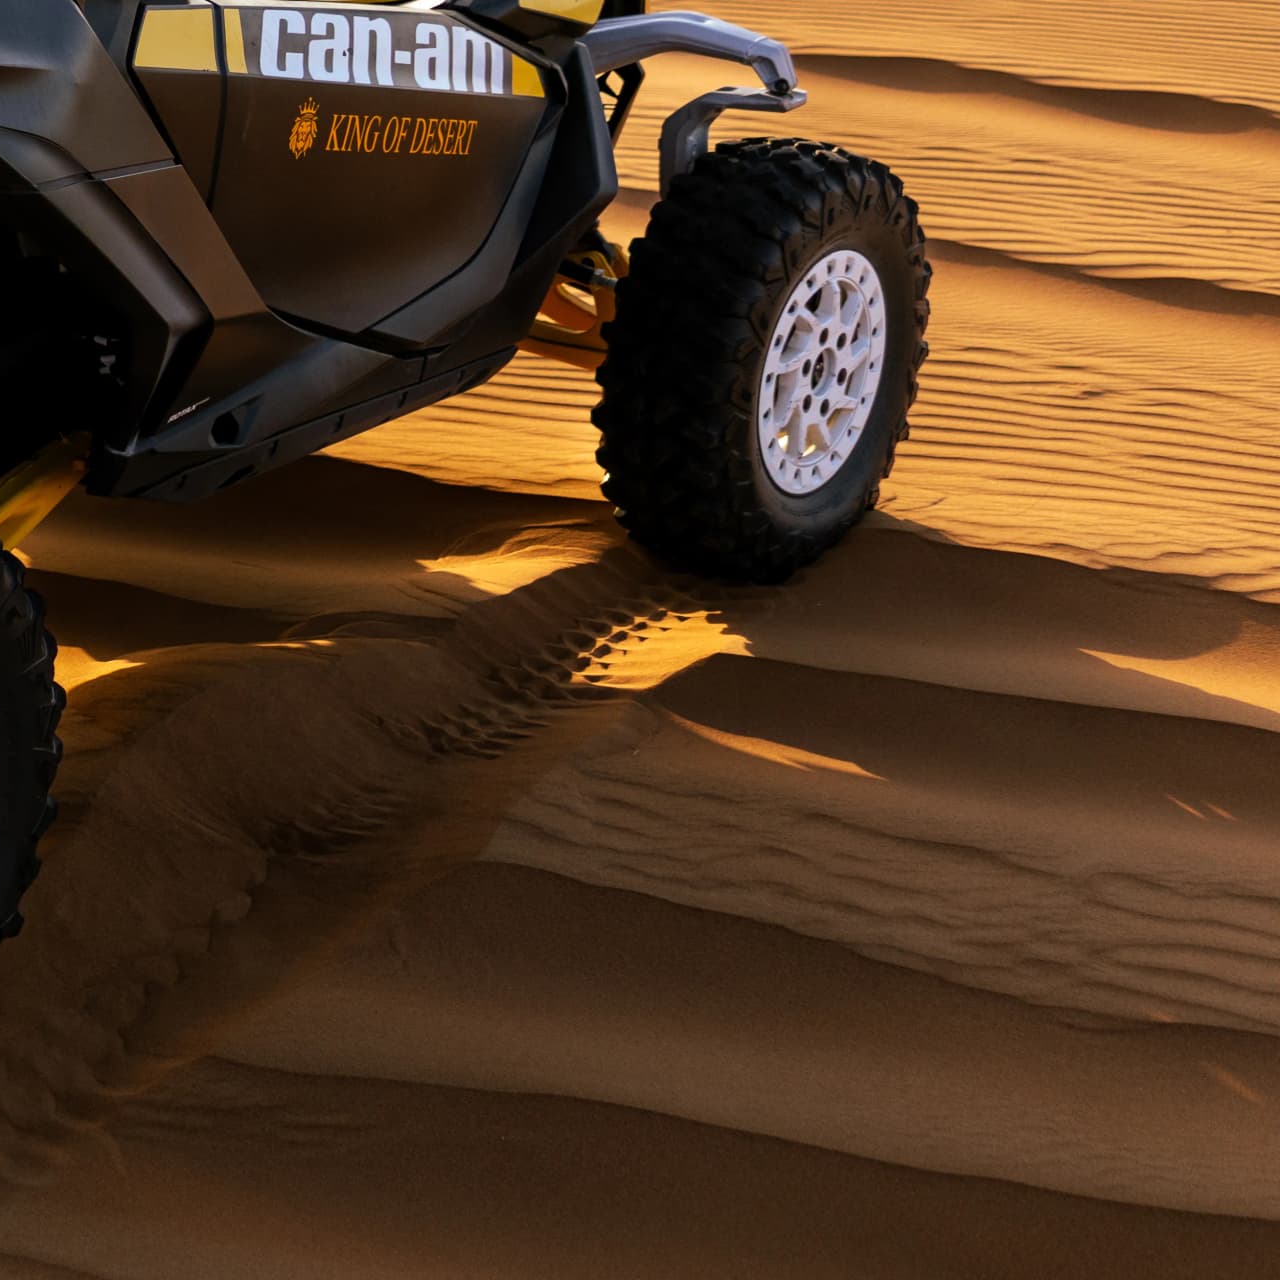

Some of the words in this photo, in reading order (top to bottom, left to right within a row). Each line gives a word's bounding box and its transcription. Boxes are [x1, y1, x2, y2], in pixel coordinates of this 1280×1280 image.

[259, 9, 504, 95] can-am
[325, 114, 382, 153] KING
[382, 116, 412, 153] OF
[409, 118, 479, 155] DESERT
